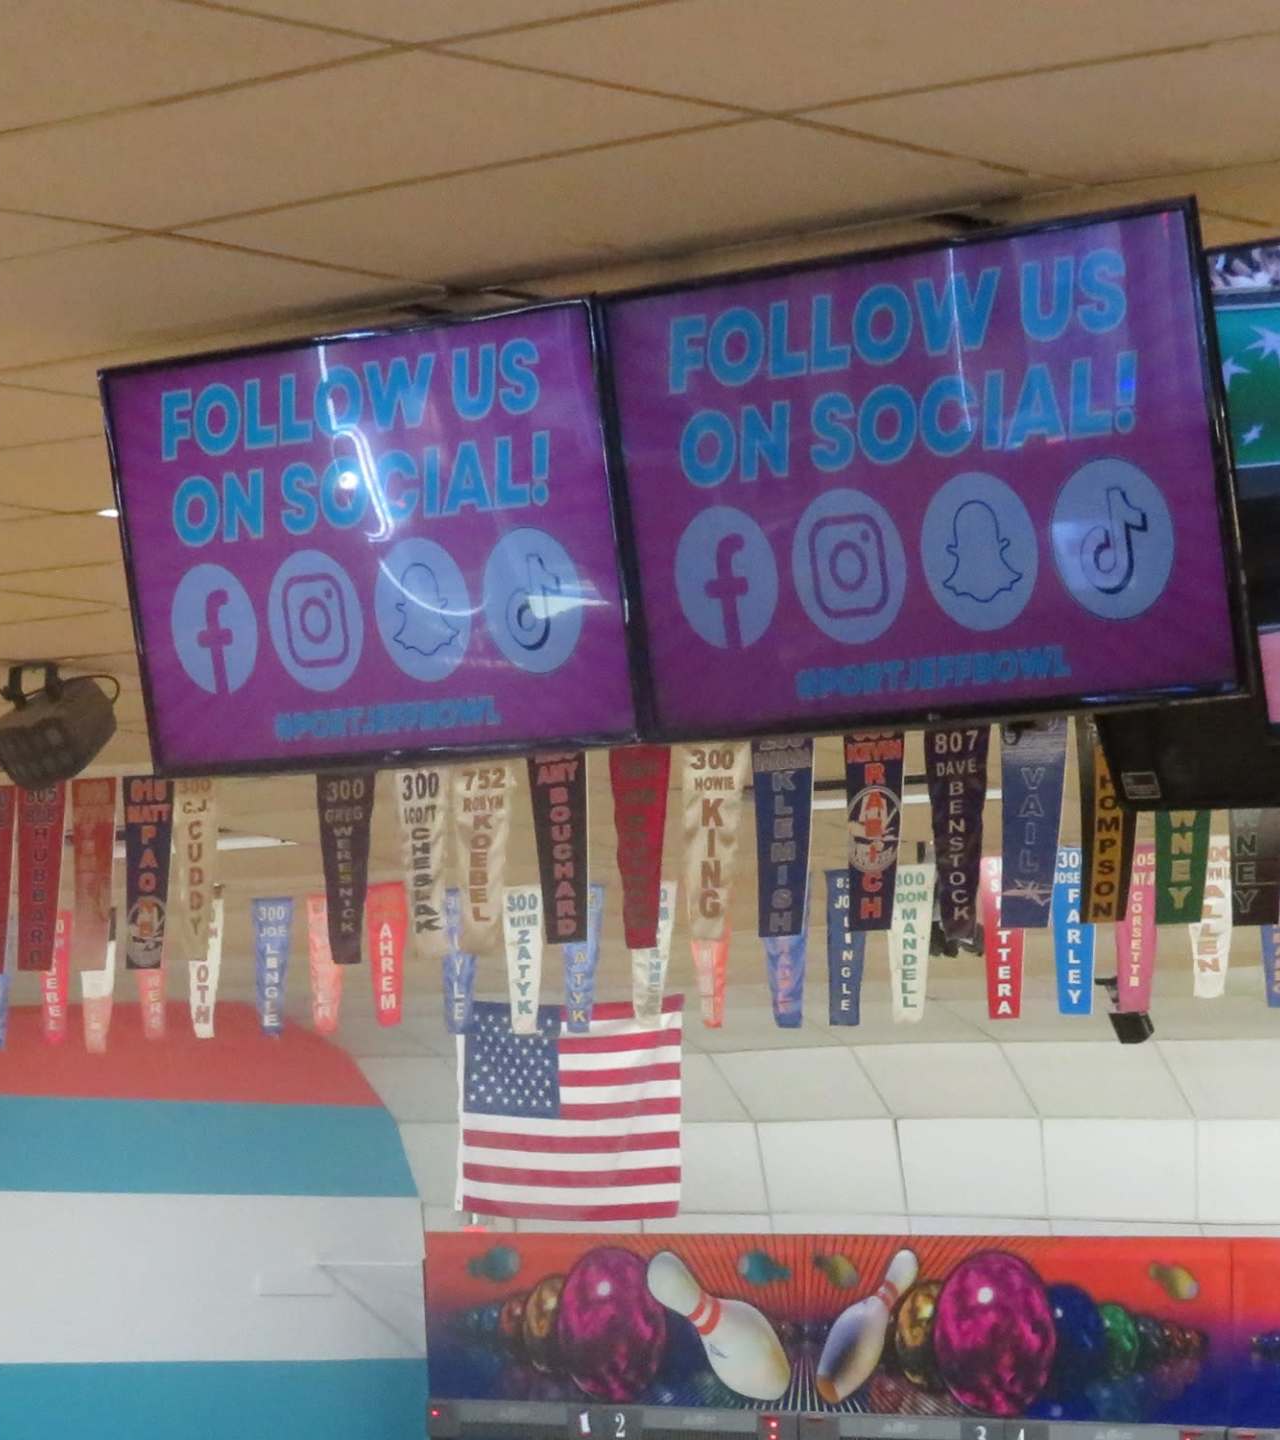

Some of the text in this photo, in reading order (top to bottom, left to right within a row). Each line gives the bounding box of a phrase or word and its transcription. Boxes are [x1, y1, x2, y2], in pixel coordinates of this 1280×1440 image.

[668, 248, 1127, 395] FOLLOW US
[161, 338, 539, 461] FOLLOW US
[680, 350, 1137, 488] ON SOCIAL!
[172, 431, 550, 547] ON SOCIAL!
[462, 768, 506, 790] 752
[690, 750, 735, 770] 300
[694, 776, 736, 791] HOWIE
[934, 729, 978, 754] 807
[936, 757, 977, 776] DAVE
[328, 779, 365, 801] 300
[402, 773, 440, 801] 300
[187, 821, 206, 936] CUDDY
[699, 798, 725, 921] KING
[948, 781, 970, 921] BENSTOCK
[1058, 851, 1081, 869] 30
[1091, 774, 1121, 919] HOMPSON
[259, 906, 286, 922] 300
[507, 893, 539, 913] 300
[378, 922, 398, 1010] AHREM
[515, 930, 534, 1016] ZATYK
[901, 907, 917, 1009] MANDELL
[1067, 888, 1083, 1006] FARLEY
[614, 1412, 627, 1439] 2
